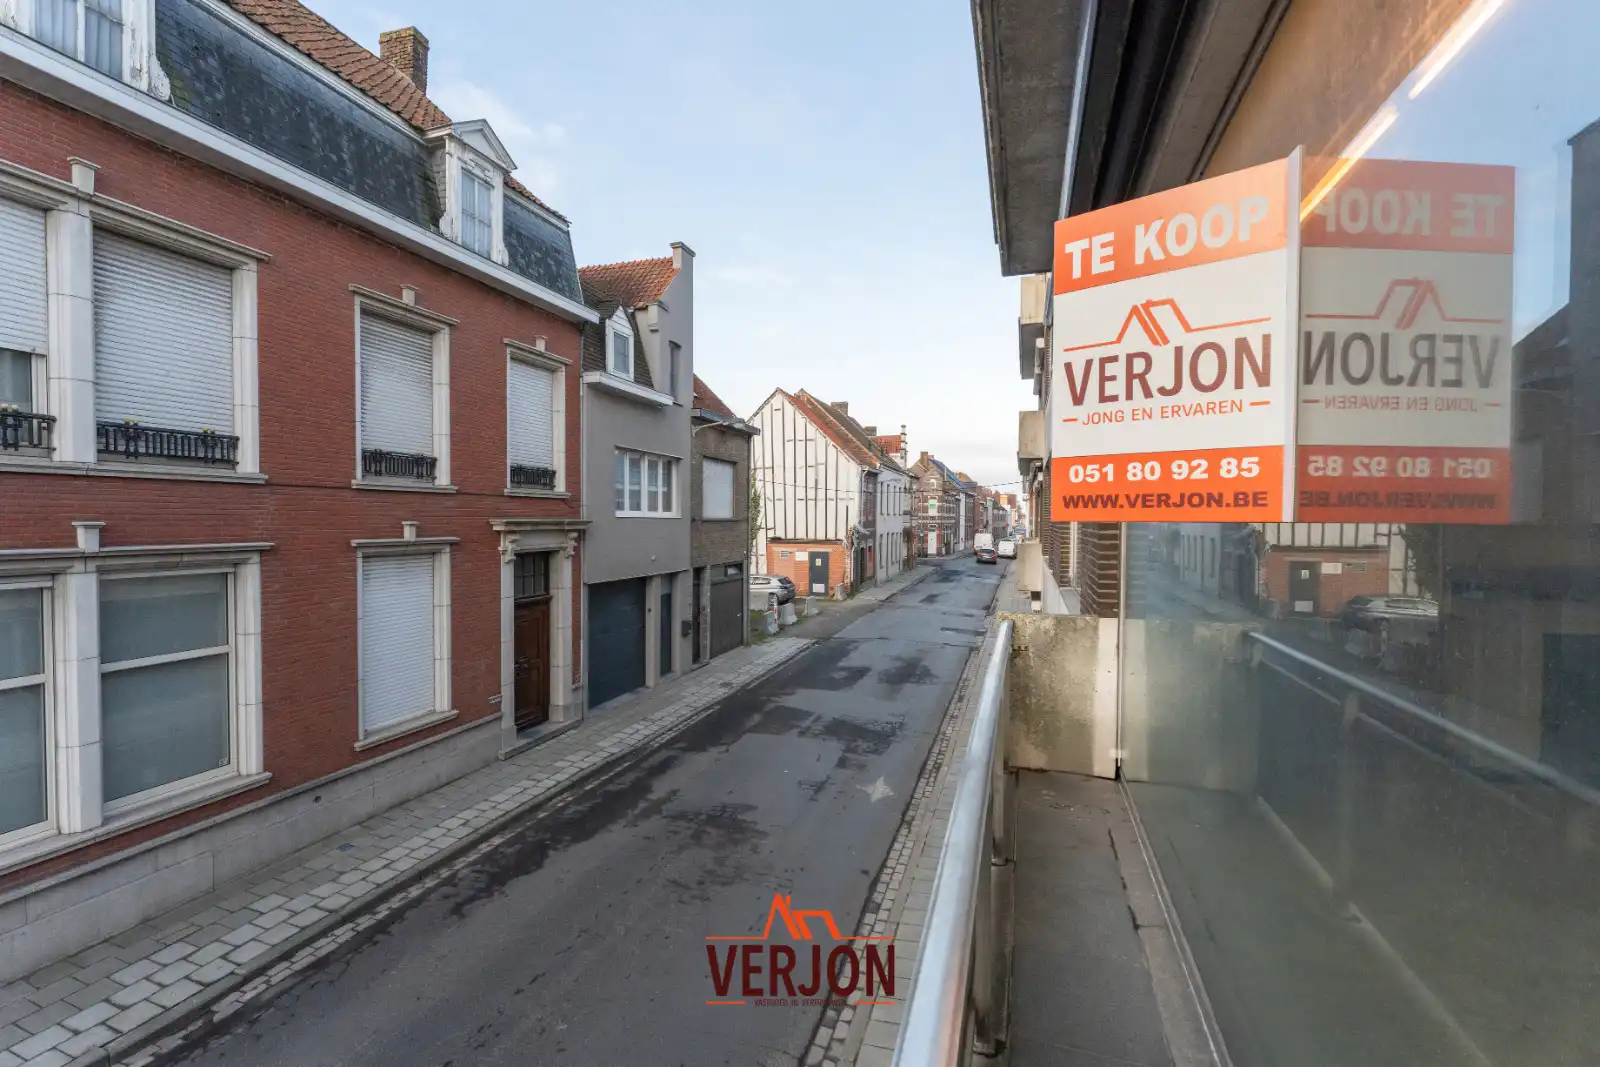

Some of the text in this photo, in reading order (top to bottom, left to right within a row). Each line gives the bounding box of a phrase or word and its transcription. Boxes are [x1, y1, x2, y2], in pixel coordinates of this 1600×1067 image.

[1064, 195, 1269, 280] TE KOOP
[1063, 333, 1272, 407] VERJON
[1082, 398, 1243, 426] JONG EN ERVAREN
[1068, 456, 1260, 483] 051 80 92 85
[1062, 490, 1269, 509] WWW.VERJON.BE
